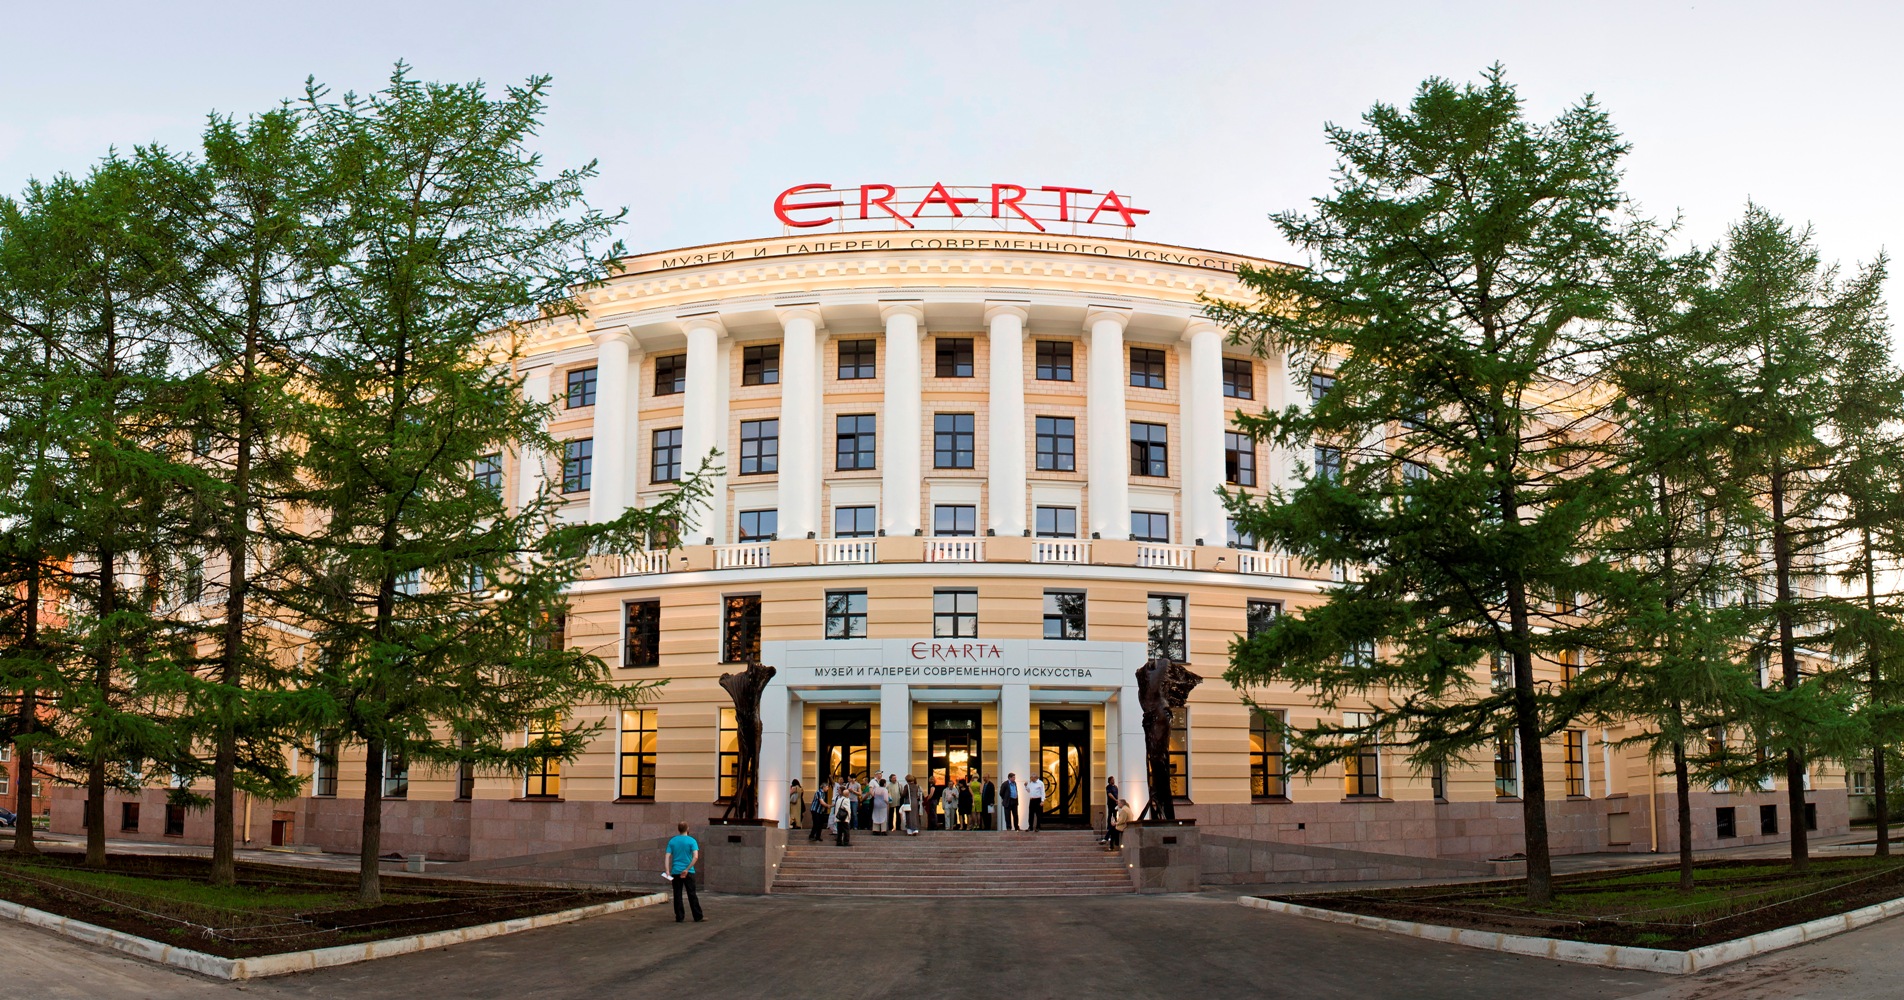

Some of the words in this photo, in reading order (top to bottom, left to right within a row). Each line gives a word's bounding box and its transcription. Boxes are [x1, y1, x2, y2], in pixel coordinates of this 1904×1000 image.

[773, 181, 1151, 232] ERARTA
[661, 249, 735, 269] МУЗЕЙ
[753, 247, 767, 257] И
[786, 239, 891, 254] ГАЛЕРЕИ
[910, 238, 1108, 255] СОВРЕМЕННОГО
[911, 641, 1004, 662] ERARTA
[814, 666, 853, 677] МУЗЕЙ
[856, 667, 865, 677] И
[867, 667, 920, 677] ГАЛЕРЕИ
[923, 666, 1021, 677] СОВРЕМЕННОГО
[1023, 667, 1093, 678] ИСКУССТВА
